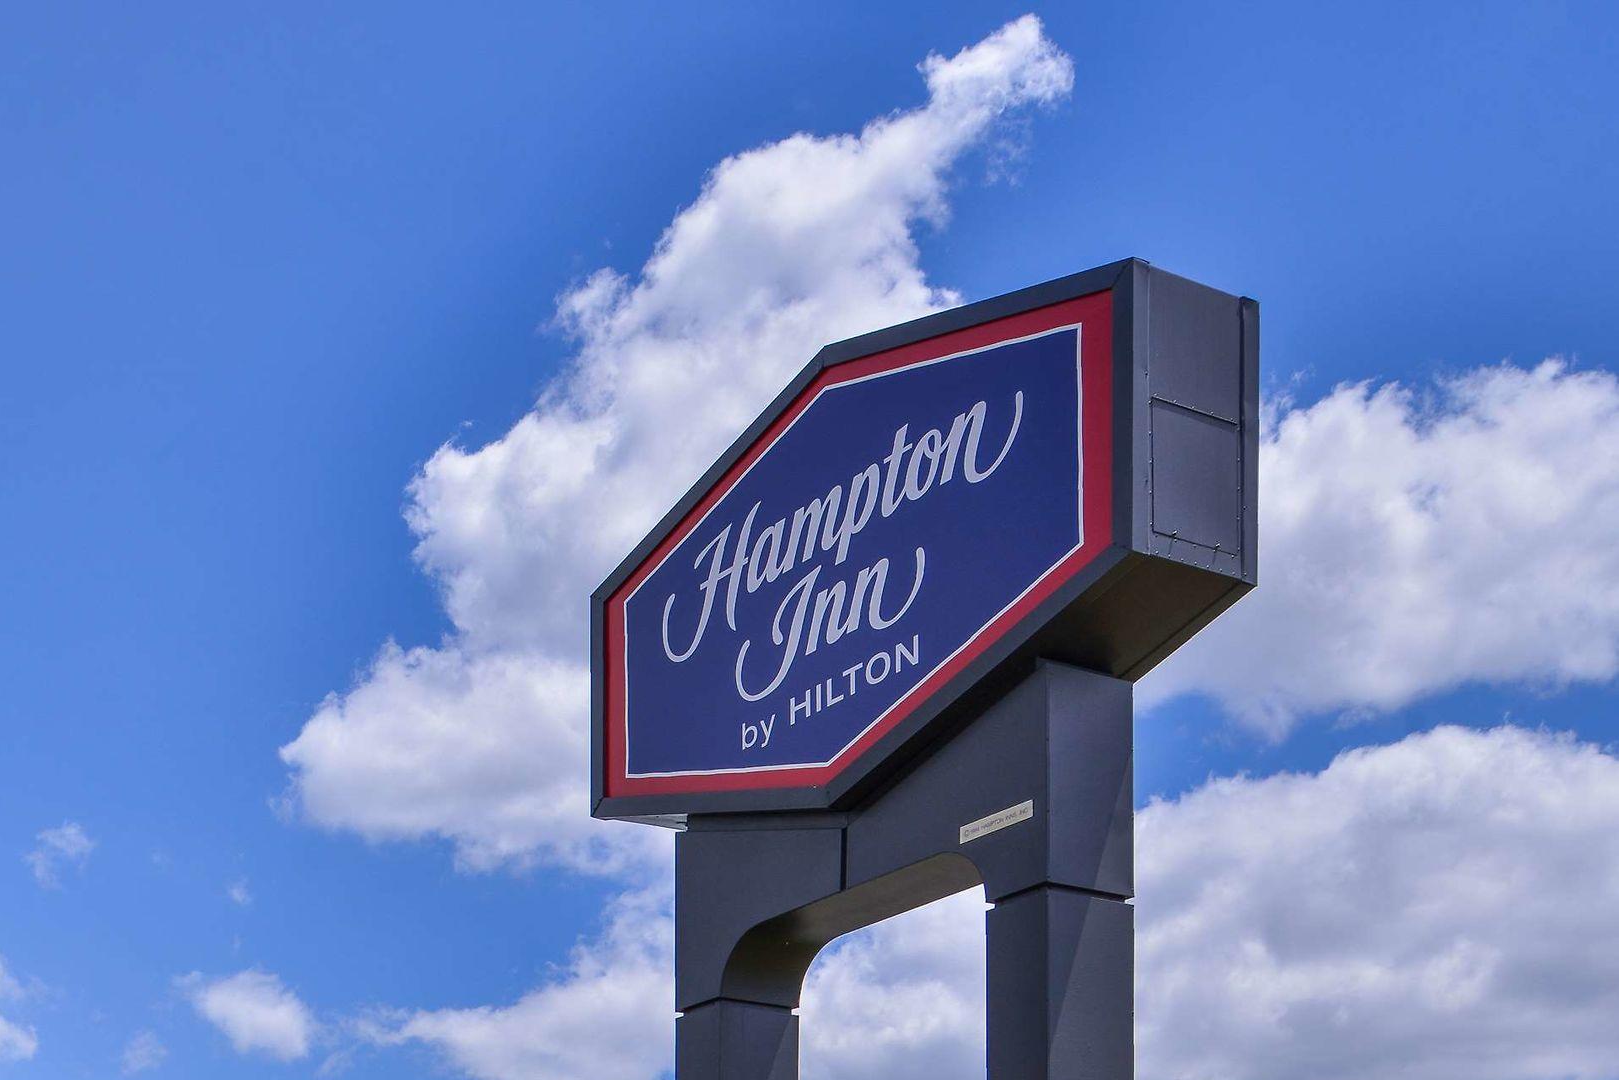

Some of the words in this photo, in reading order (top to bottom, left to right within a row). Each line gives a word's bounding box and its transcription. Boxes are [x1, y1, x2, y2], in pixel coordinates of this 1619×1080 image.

[662, 390, 1023, 662] Hampton
[735, 547, 925, 701] Inn
[740, 712, 776, 750] by
[789, 635, 920, 725] HILTON
